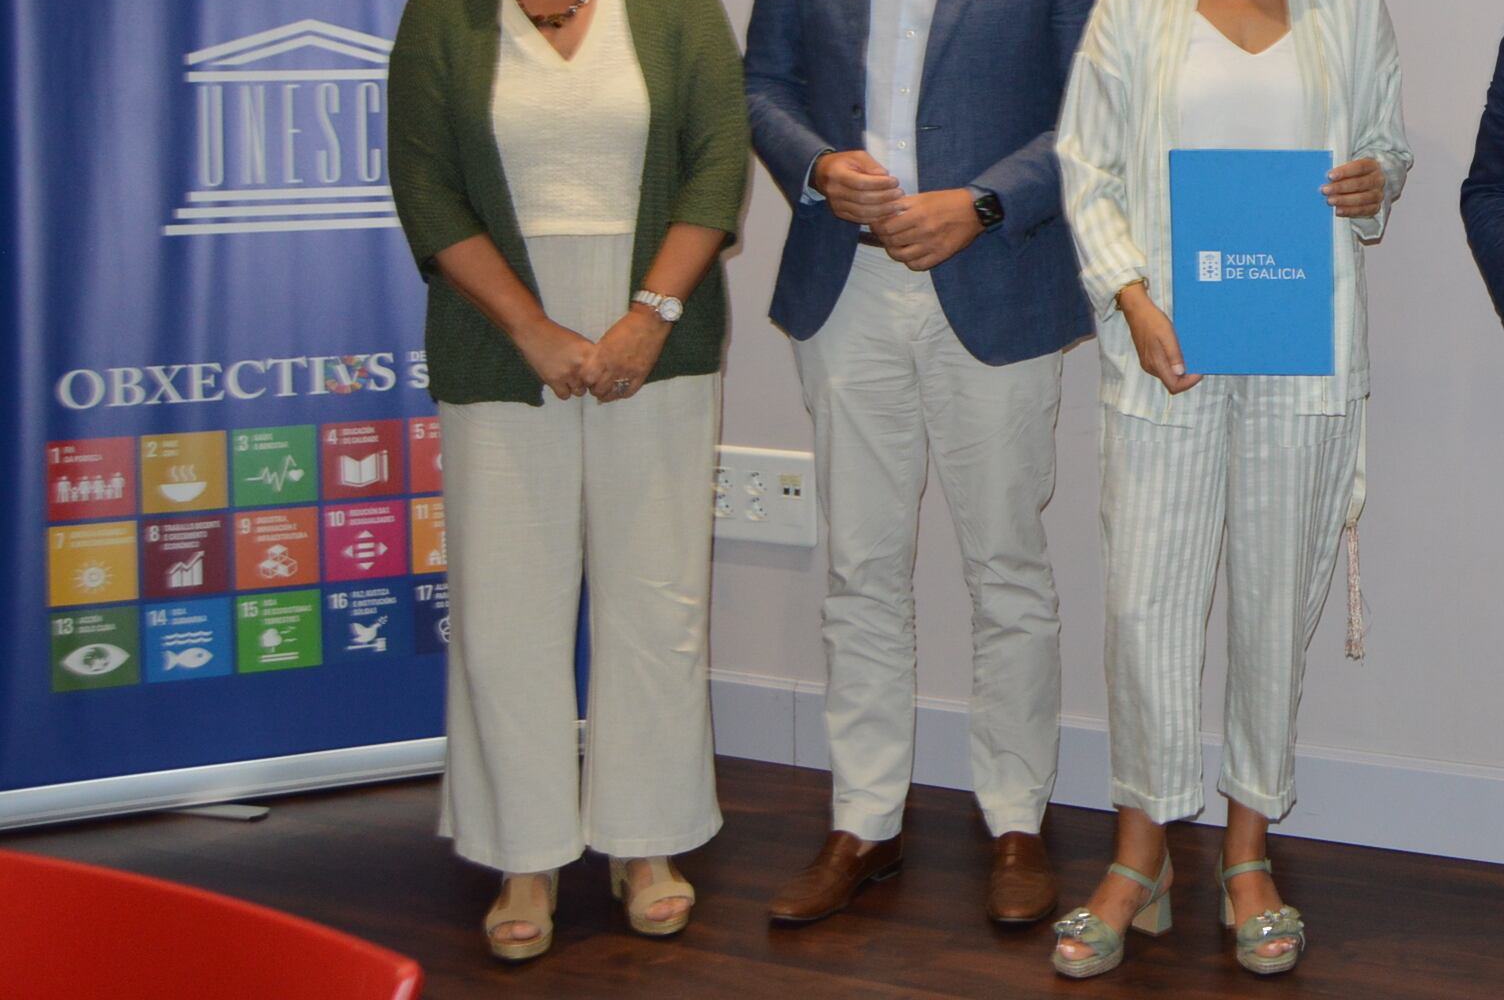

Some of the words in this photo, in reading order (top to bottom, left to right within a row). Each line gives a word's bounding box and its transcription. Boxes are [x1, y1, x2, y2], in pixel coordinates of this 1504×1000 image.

[198, 81, 382, 187] UNESC
[1226, 254, 1276, 266] XUNTA
[1226, 267, 1245, 280] DE
[1248, 267, 1306, 280] GALICIA
[410, 363, 430, 389] S
[327, 429, 338, 445] 4
[415, 423, 425, 439] 5
[146, 441, 157, 458] 2
[237, 435, 248, 451] 3
[51, 447, 60, 464] 1
[328, 510, 345, 527] 10
[415, 504, 429, 520] 11
[148, 525, 160, 542] 8
[239, 518, 250, 535] 9
[329, 592, 348, 609] 16
[417, 584, 433, 601] 17
[148, 609, 167, 626] 14
[240, 601, 259, 618] 15
[55, 617, 74, 635] 13
